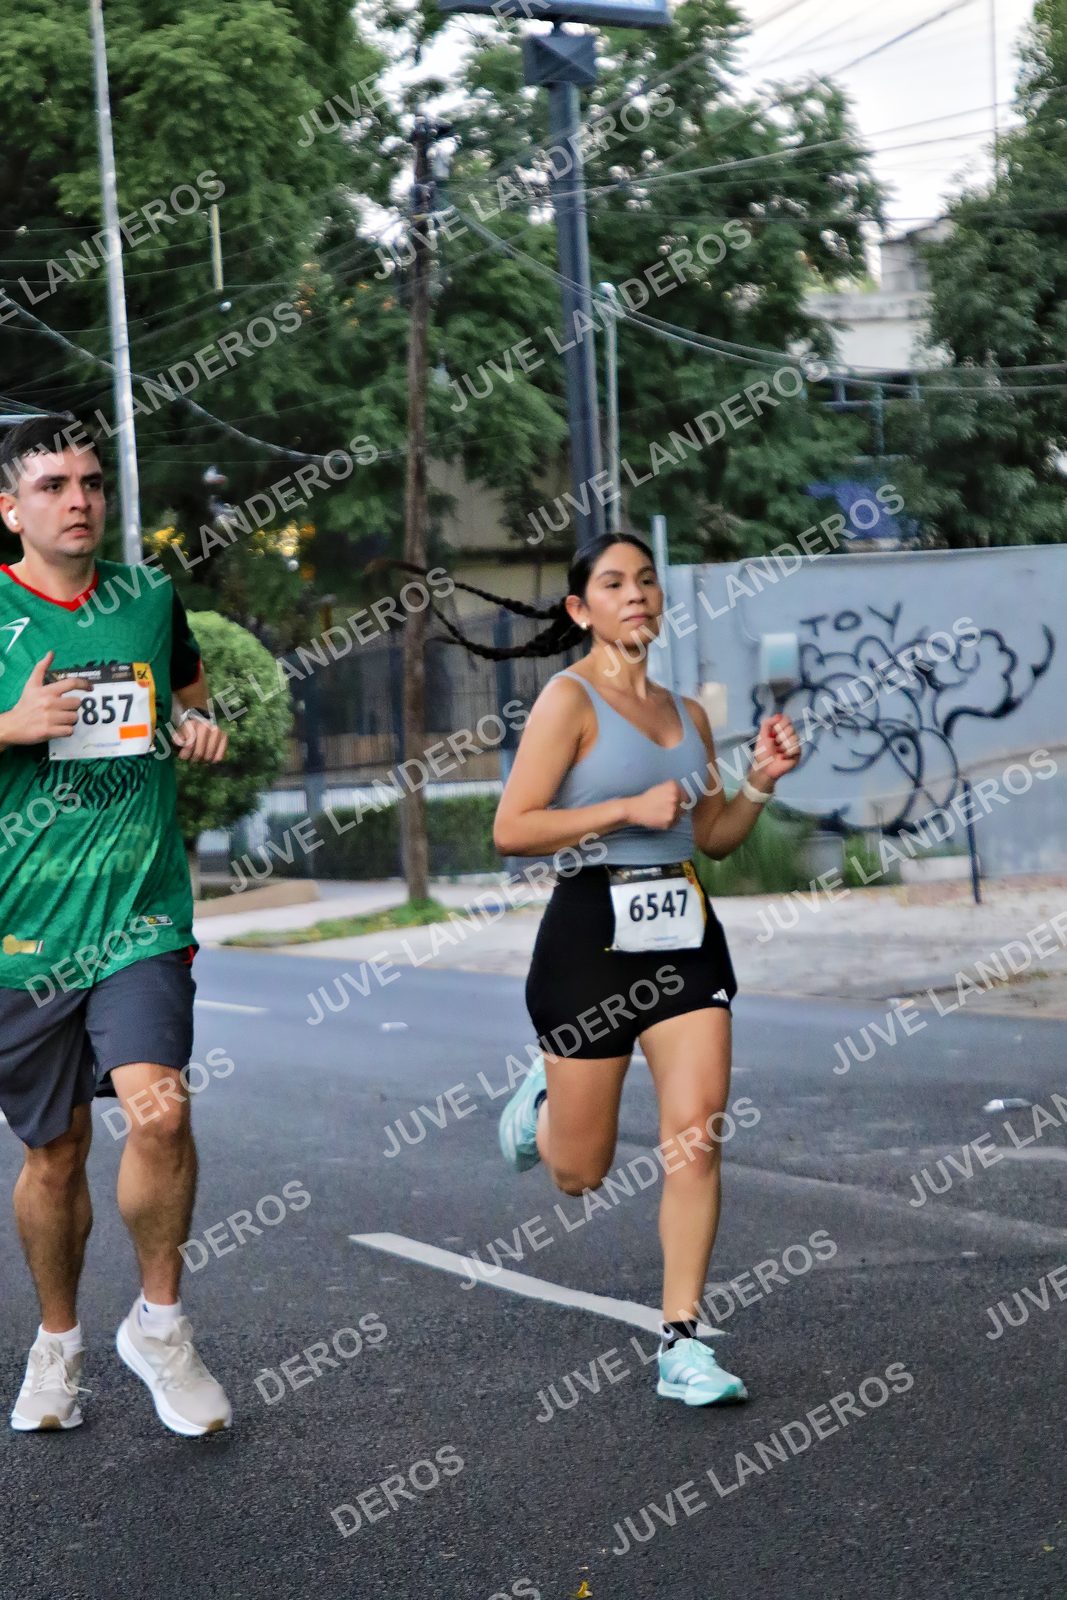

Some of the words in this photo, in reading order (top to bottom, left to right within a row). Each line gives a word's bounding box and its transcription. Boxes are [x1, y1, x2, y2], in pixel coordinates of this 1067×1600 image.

[799, 600, 903, 642] TOY
[81, 692, 134, 726] 857
[628, 888, 688, 923] 6547
